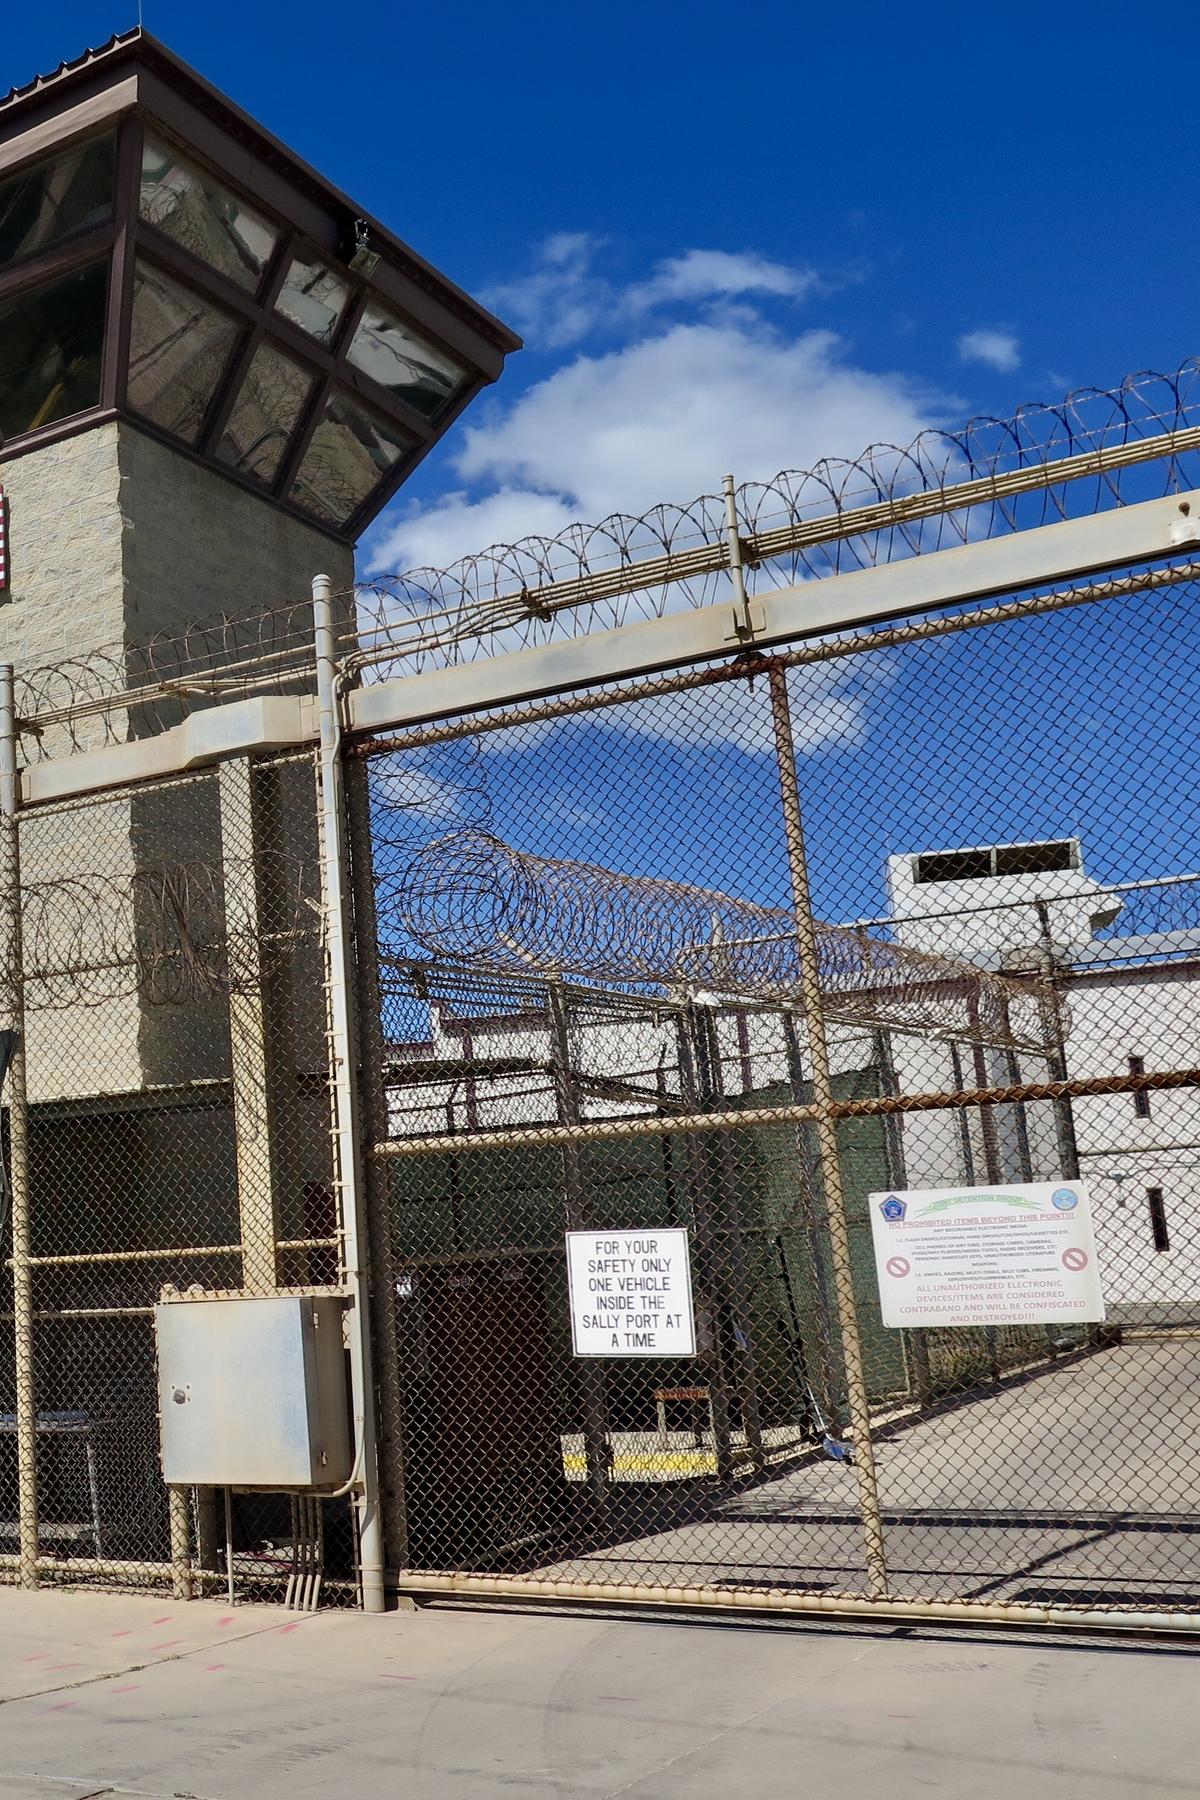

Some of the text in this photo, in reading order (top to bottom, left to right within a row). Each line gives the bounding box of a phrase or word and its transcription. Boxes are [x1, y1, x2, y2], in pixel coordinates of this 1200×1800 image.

[903, 1218, 951, 1228] PROHIBITED
[953, 1216, 978, 1225] ITEMS
[980, 1214, 1016, 1223] BEYOND
[1018, 1213, 1037, 1221] THIS
[596, 1240, 658, 1254] FOR YOUR
[588, 1258, 672, 1272] SAFETY ONLY
[588, 1277, 670, 1291] ONE VEHICLE
[933, 1282, 1004, 1291] UNAUTHORIZED
[1007, 1280, 1062, 1288] ELECTRONIC
[596, 1296, 665, 1310] INSIDE THE
[916, 1293, 984, 1302] DEVICES/ITEMS
[1006, 1290, 1064, 1299] CONSIDERED
[899, 1304, 961, 1313] CONTRABAND
[1022, 1300, 1086, 1309] CONFISCATED
[582, 1314, 682, 1328] SALLY PORT AT
[611, 1333, 656, 1347] A TIME
